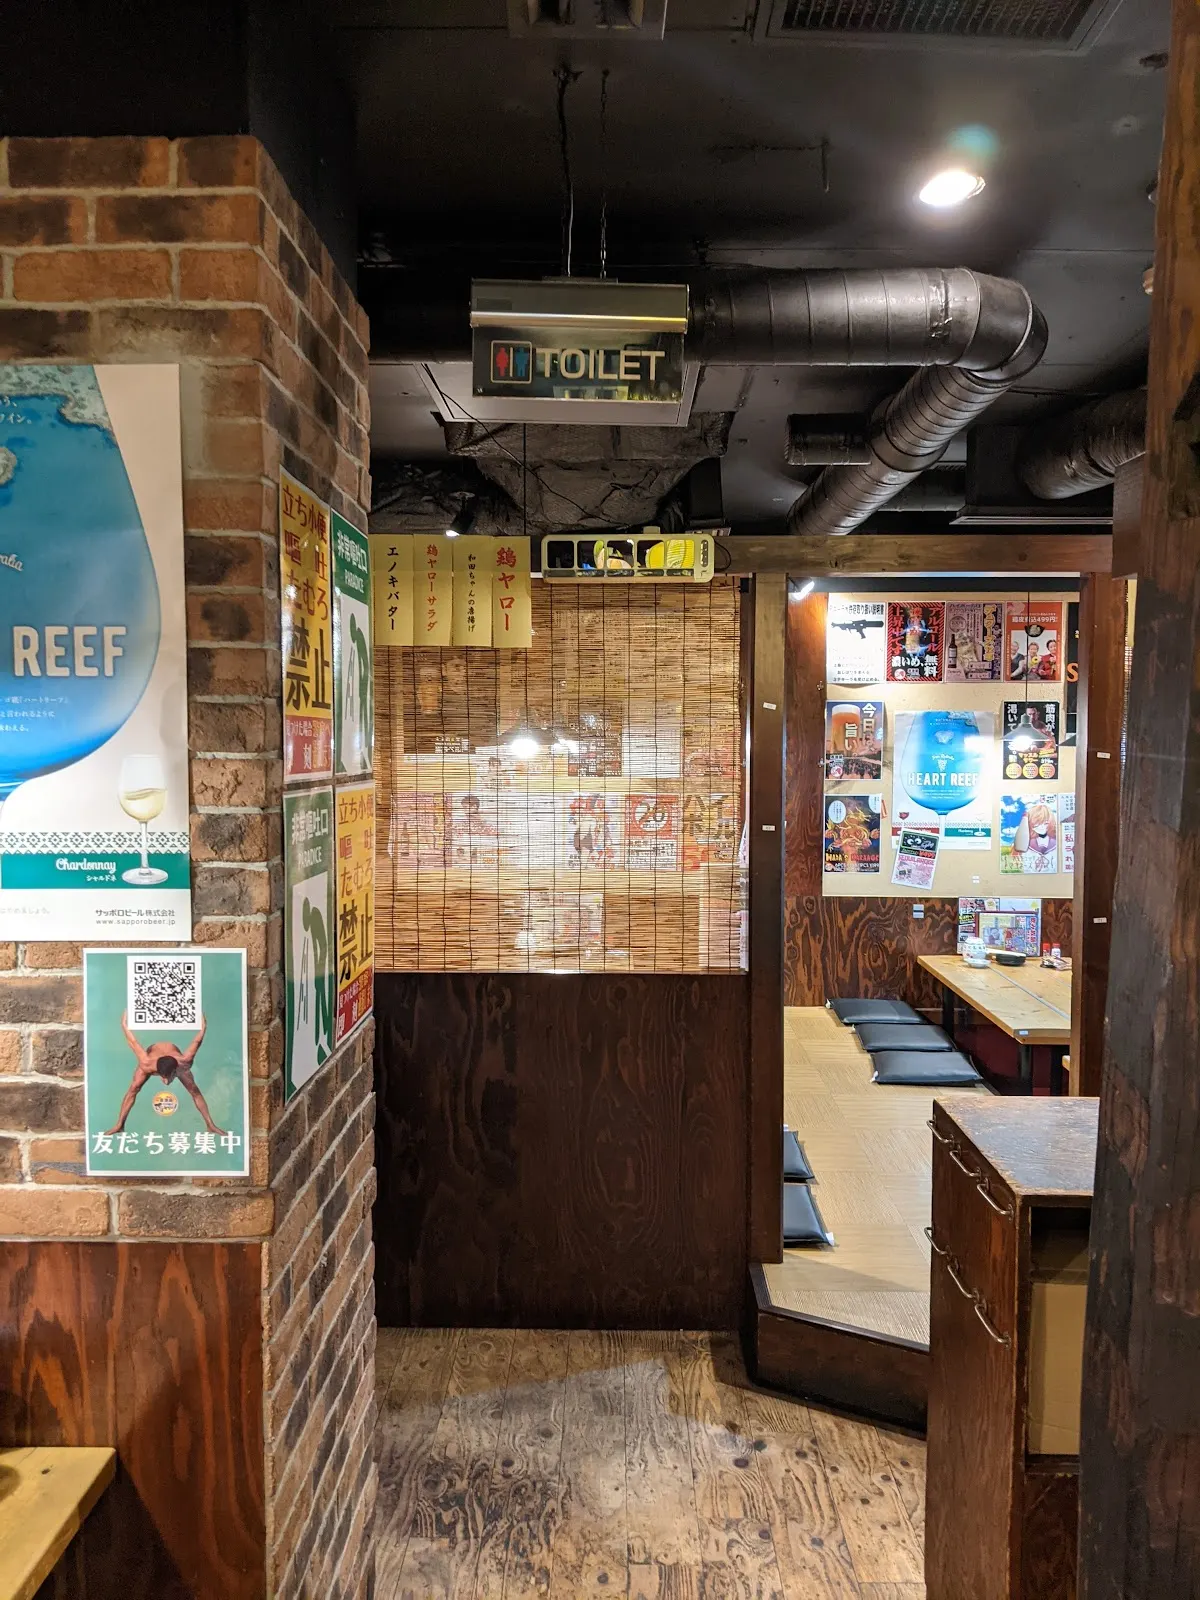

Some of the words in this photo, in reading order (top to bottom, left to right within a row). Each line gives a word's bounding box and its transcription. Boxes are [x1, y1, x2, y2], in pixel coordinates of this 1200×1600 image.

[536, 347, 666, 381] TOILET
[282, 485, 327, 544] 立ち小便
[387, 547, 399, 631] エノキバター
[426, 544, 438, 632] 鶏ヤローサラダ
[467, 553, 477, 632] 和田ちゃんの唐揚げ
[496, 546, 517, 632] 鶏ヤロー
[927, 607, 940, 652] アルコール
[12, 626, 128, 677] REEF
[286, 617, 331, 711] 禁止
[907, 772, 947, 786] HEART
[338, 793, 373, 825] 立ち小便
[55, 858, 117, 874] Chardonnay
[86, 874, 117, 882] シャルドネ
[340, 857, 373, 898] たむろ
[95, 908, 176, 918] サッポロビール株式会社
[95, 918, 176, 926] www.sapporobeer.jp
[339, 892, 373, 985] 禁止
[92, 1130, 241, 1156] 友だち募集中
